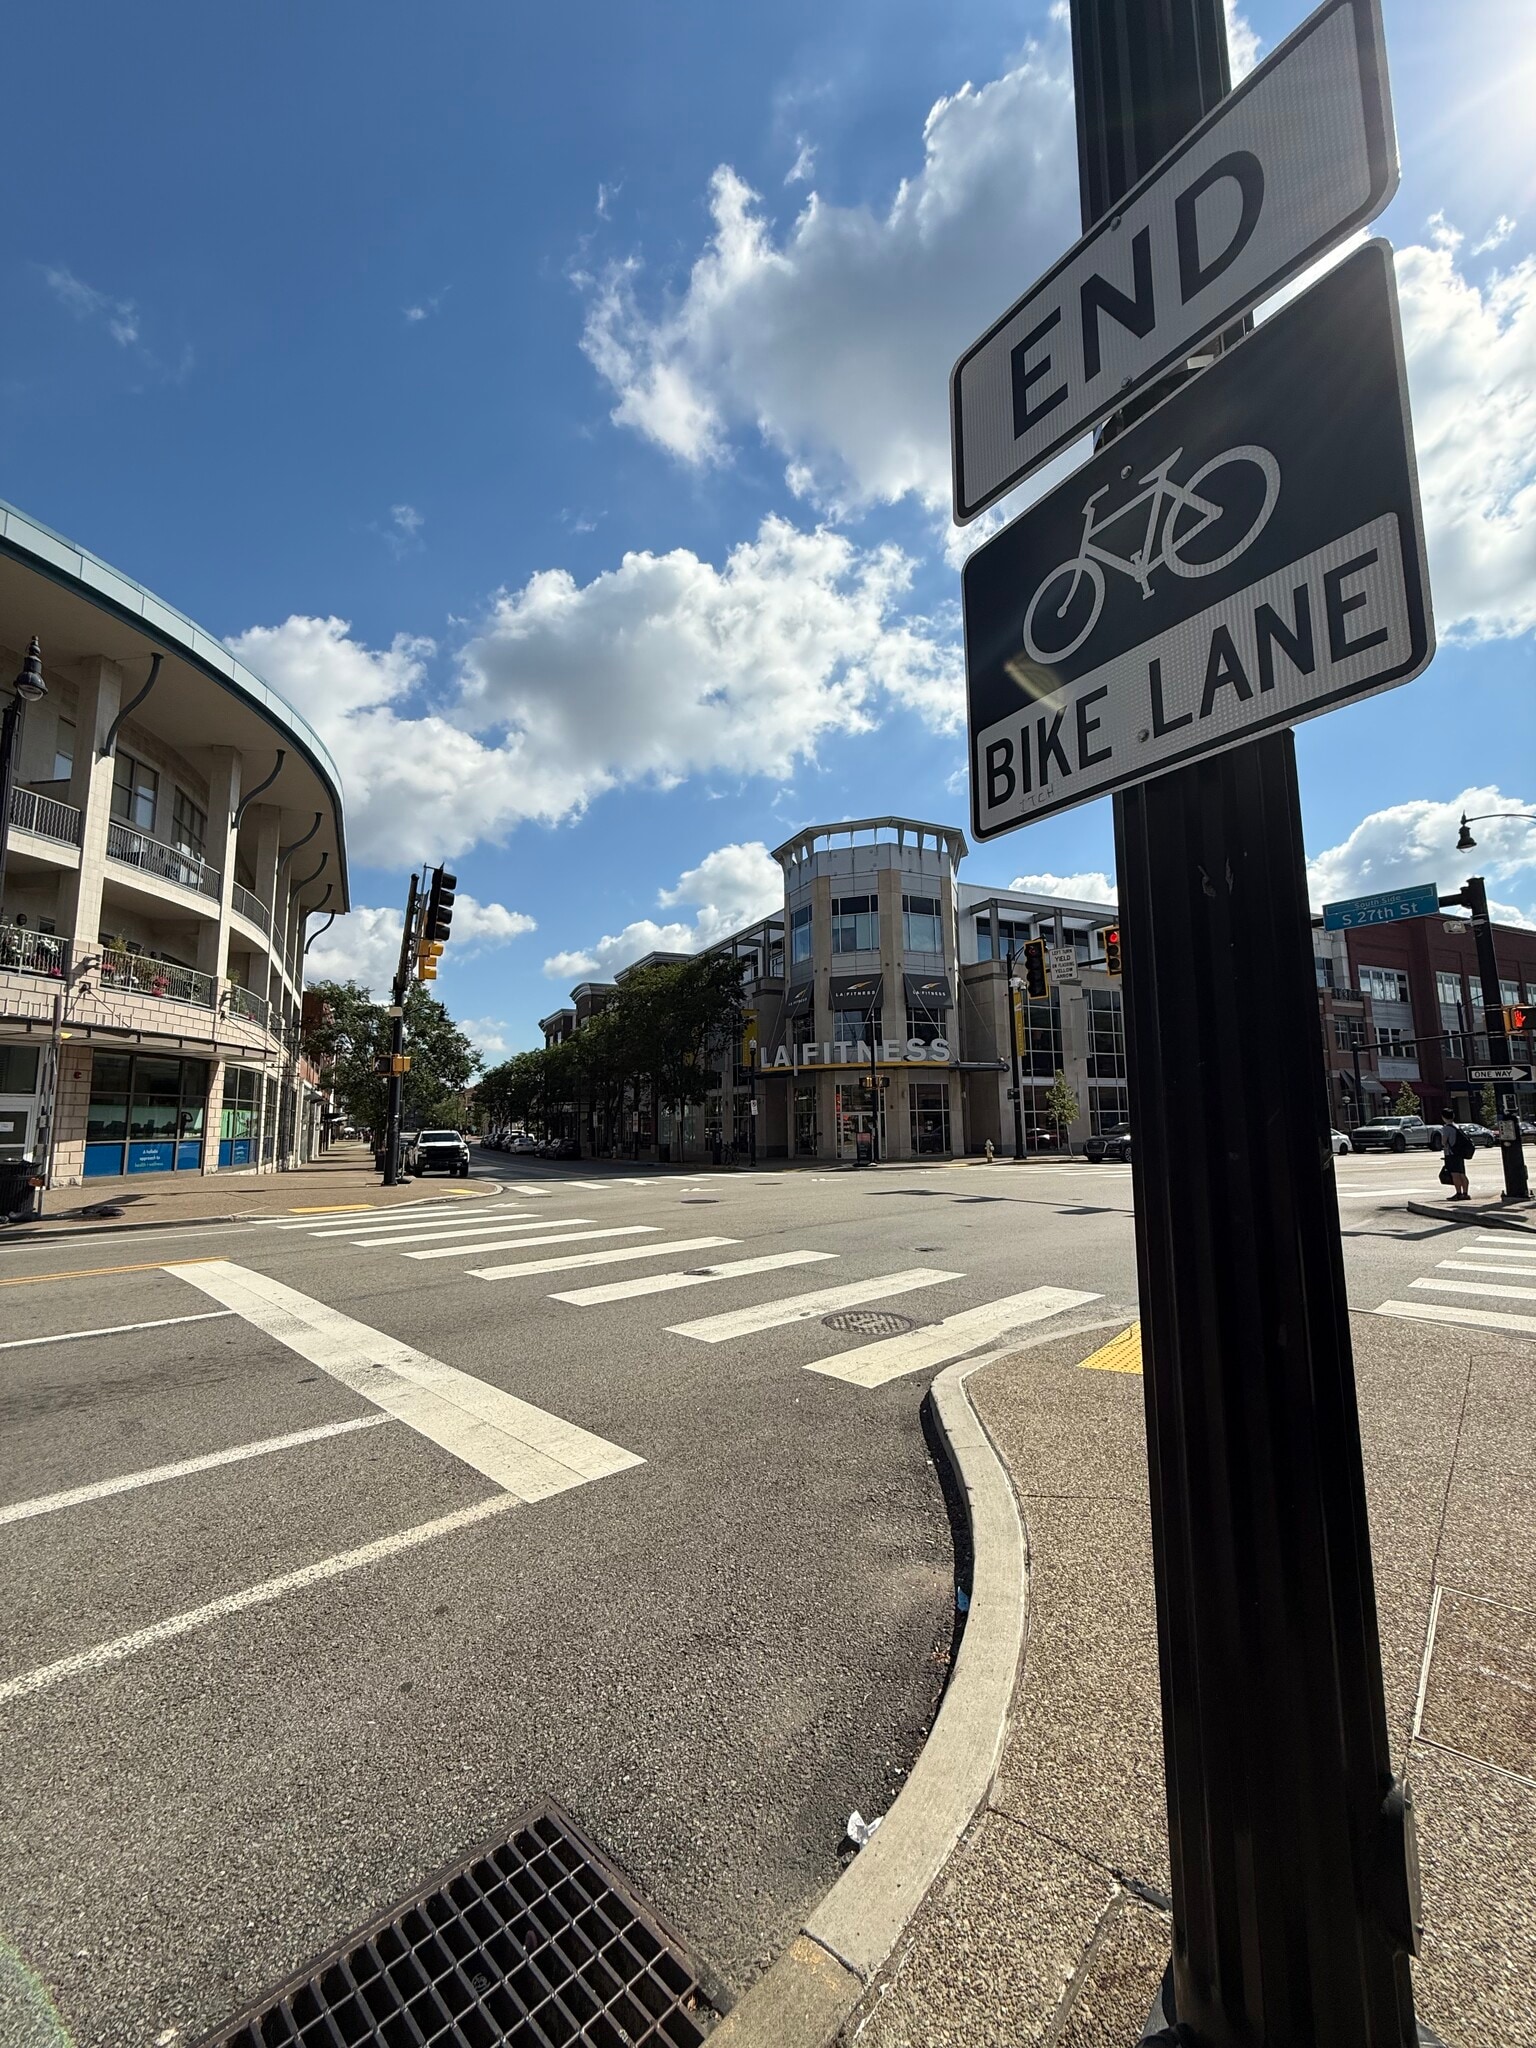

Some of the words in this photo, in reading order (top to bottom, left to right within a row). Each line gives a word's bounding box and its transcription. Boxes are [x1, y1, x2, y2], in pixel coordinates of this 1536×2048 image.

[1011, 151, 1265, 440] END
[986, 685, 1112, 810] BIKE
[1149, 547, 1388, 738] LANE
[1342, 914, 1352, 926] S
[1357, 907, 1394, 923] 27th
[1400, 902, 1418, 915] St
[1354, 900, 1379, 909] South
[1381, 895, 1401, 904] Side
[760, 1044, 792, 1069] LA
[802, 1037, 950, 1066] FITNESS
